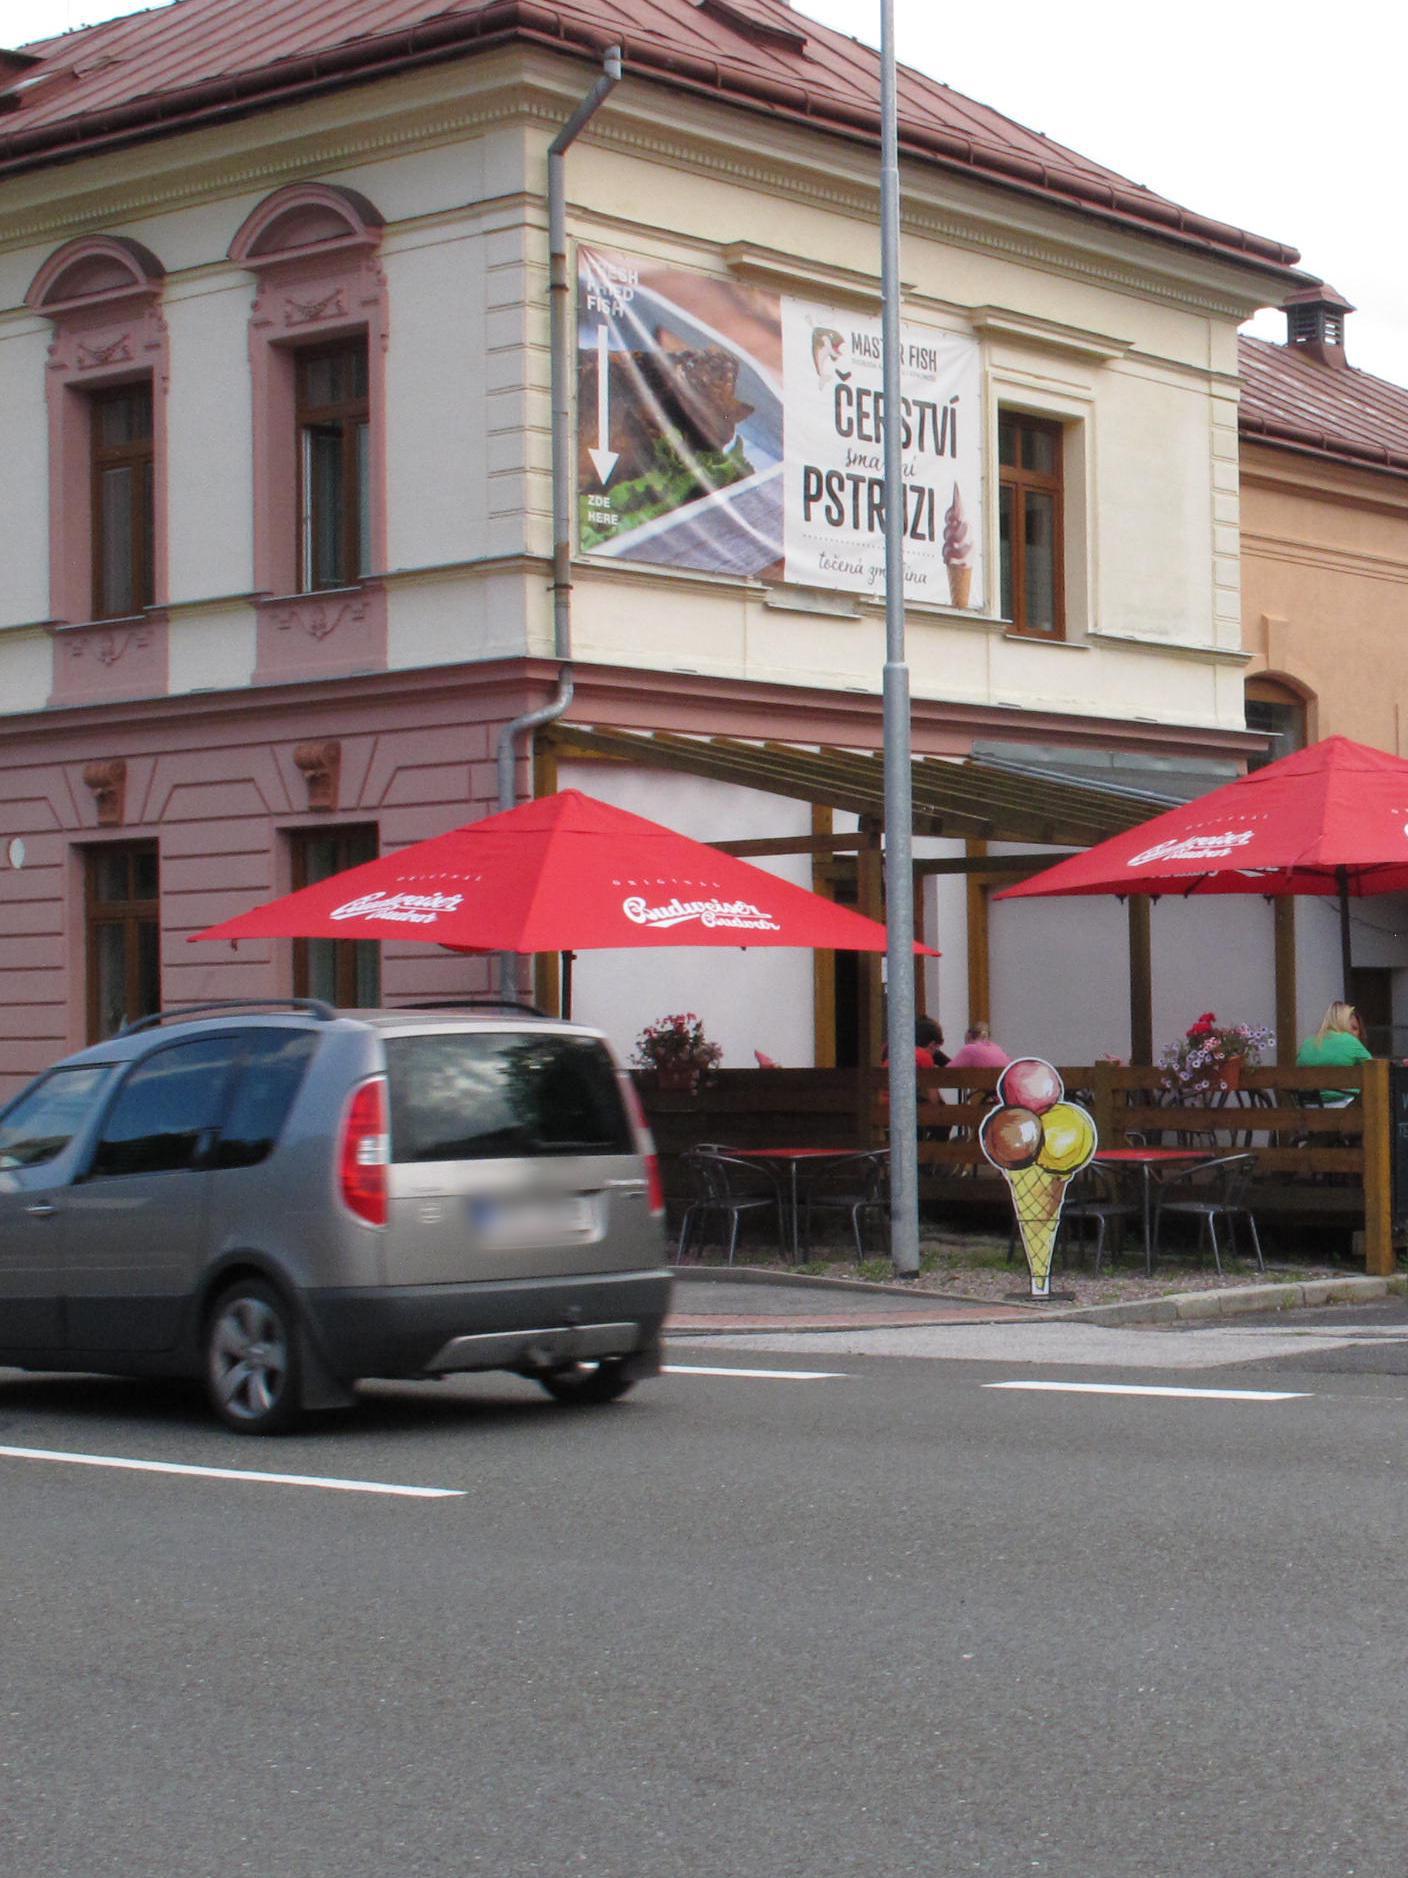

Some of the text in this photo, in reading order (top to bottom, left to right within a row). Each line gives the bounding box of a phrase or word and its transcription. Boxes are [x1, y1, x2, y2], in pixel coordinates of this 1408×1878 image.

[851, 331, 904, 365] MASR
[909, 344, 937, 373] FISH
[587, 494, 611, 509] ZDE
[587, 511, 619, 526] HERE
[623, 896, 773, 928] Budweiser
